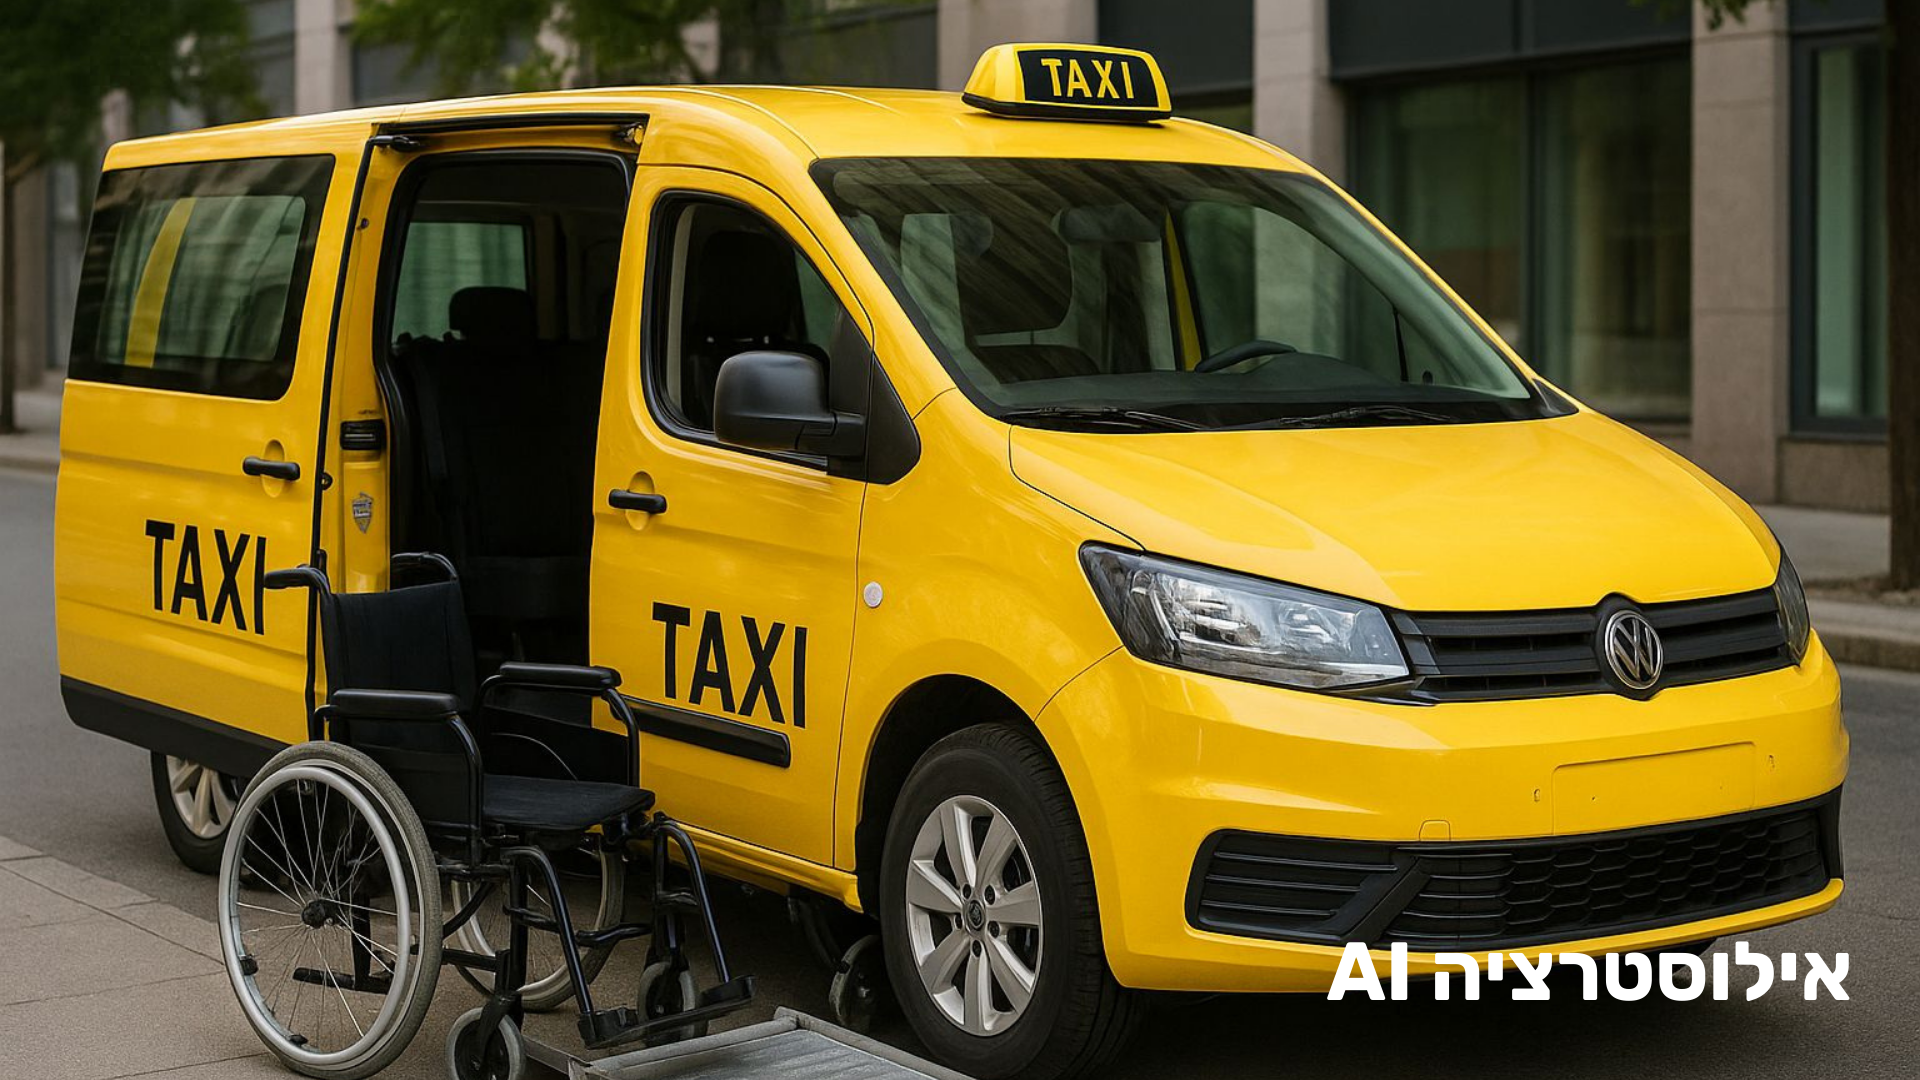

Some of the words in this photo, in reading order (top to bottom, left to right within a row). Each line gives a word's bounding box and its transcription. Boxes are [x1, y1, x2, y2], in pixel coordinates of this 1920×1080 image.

[1040, 58, 1135, 99] TAXI
[145, 519, 266, 636] TAXI
[652, 601, 808, 729] TAXI
